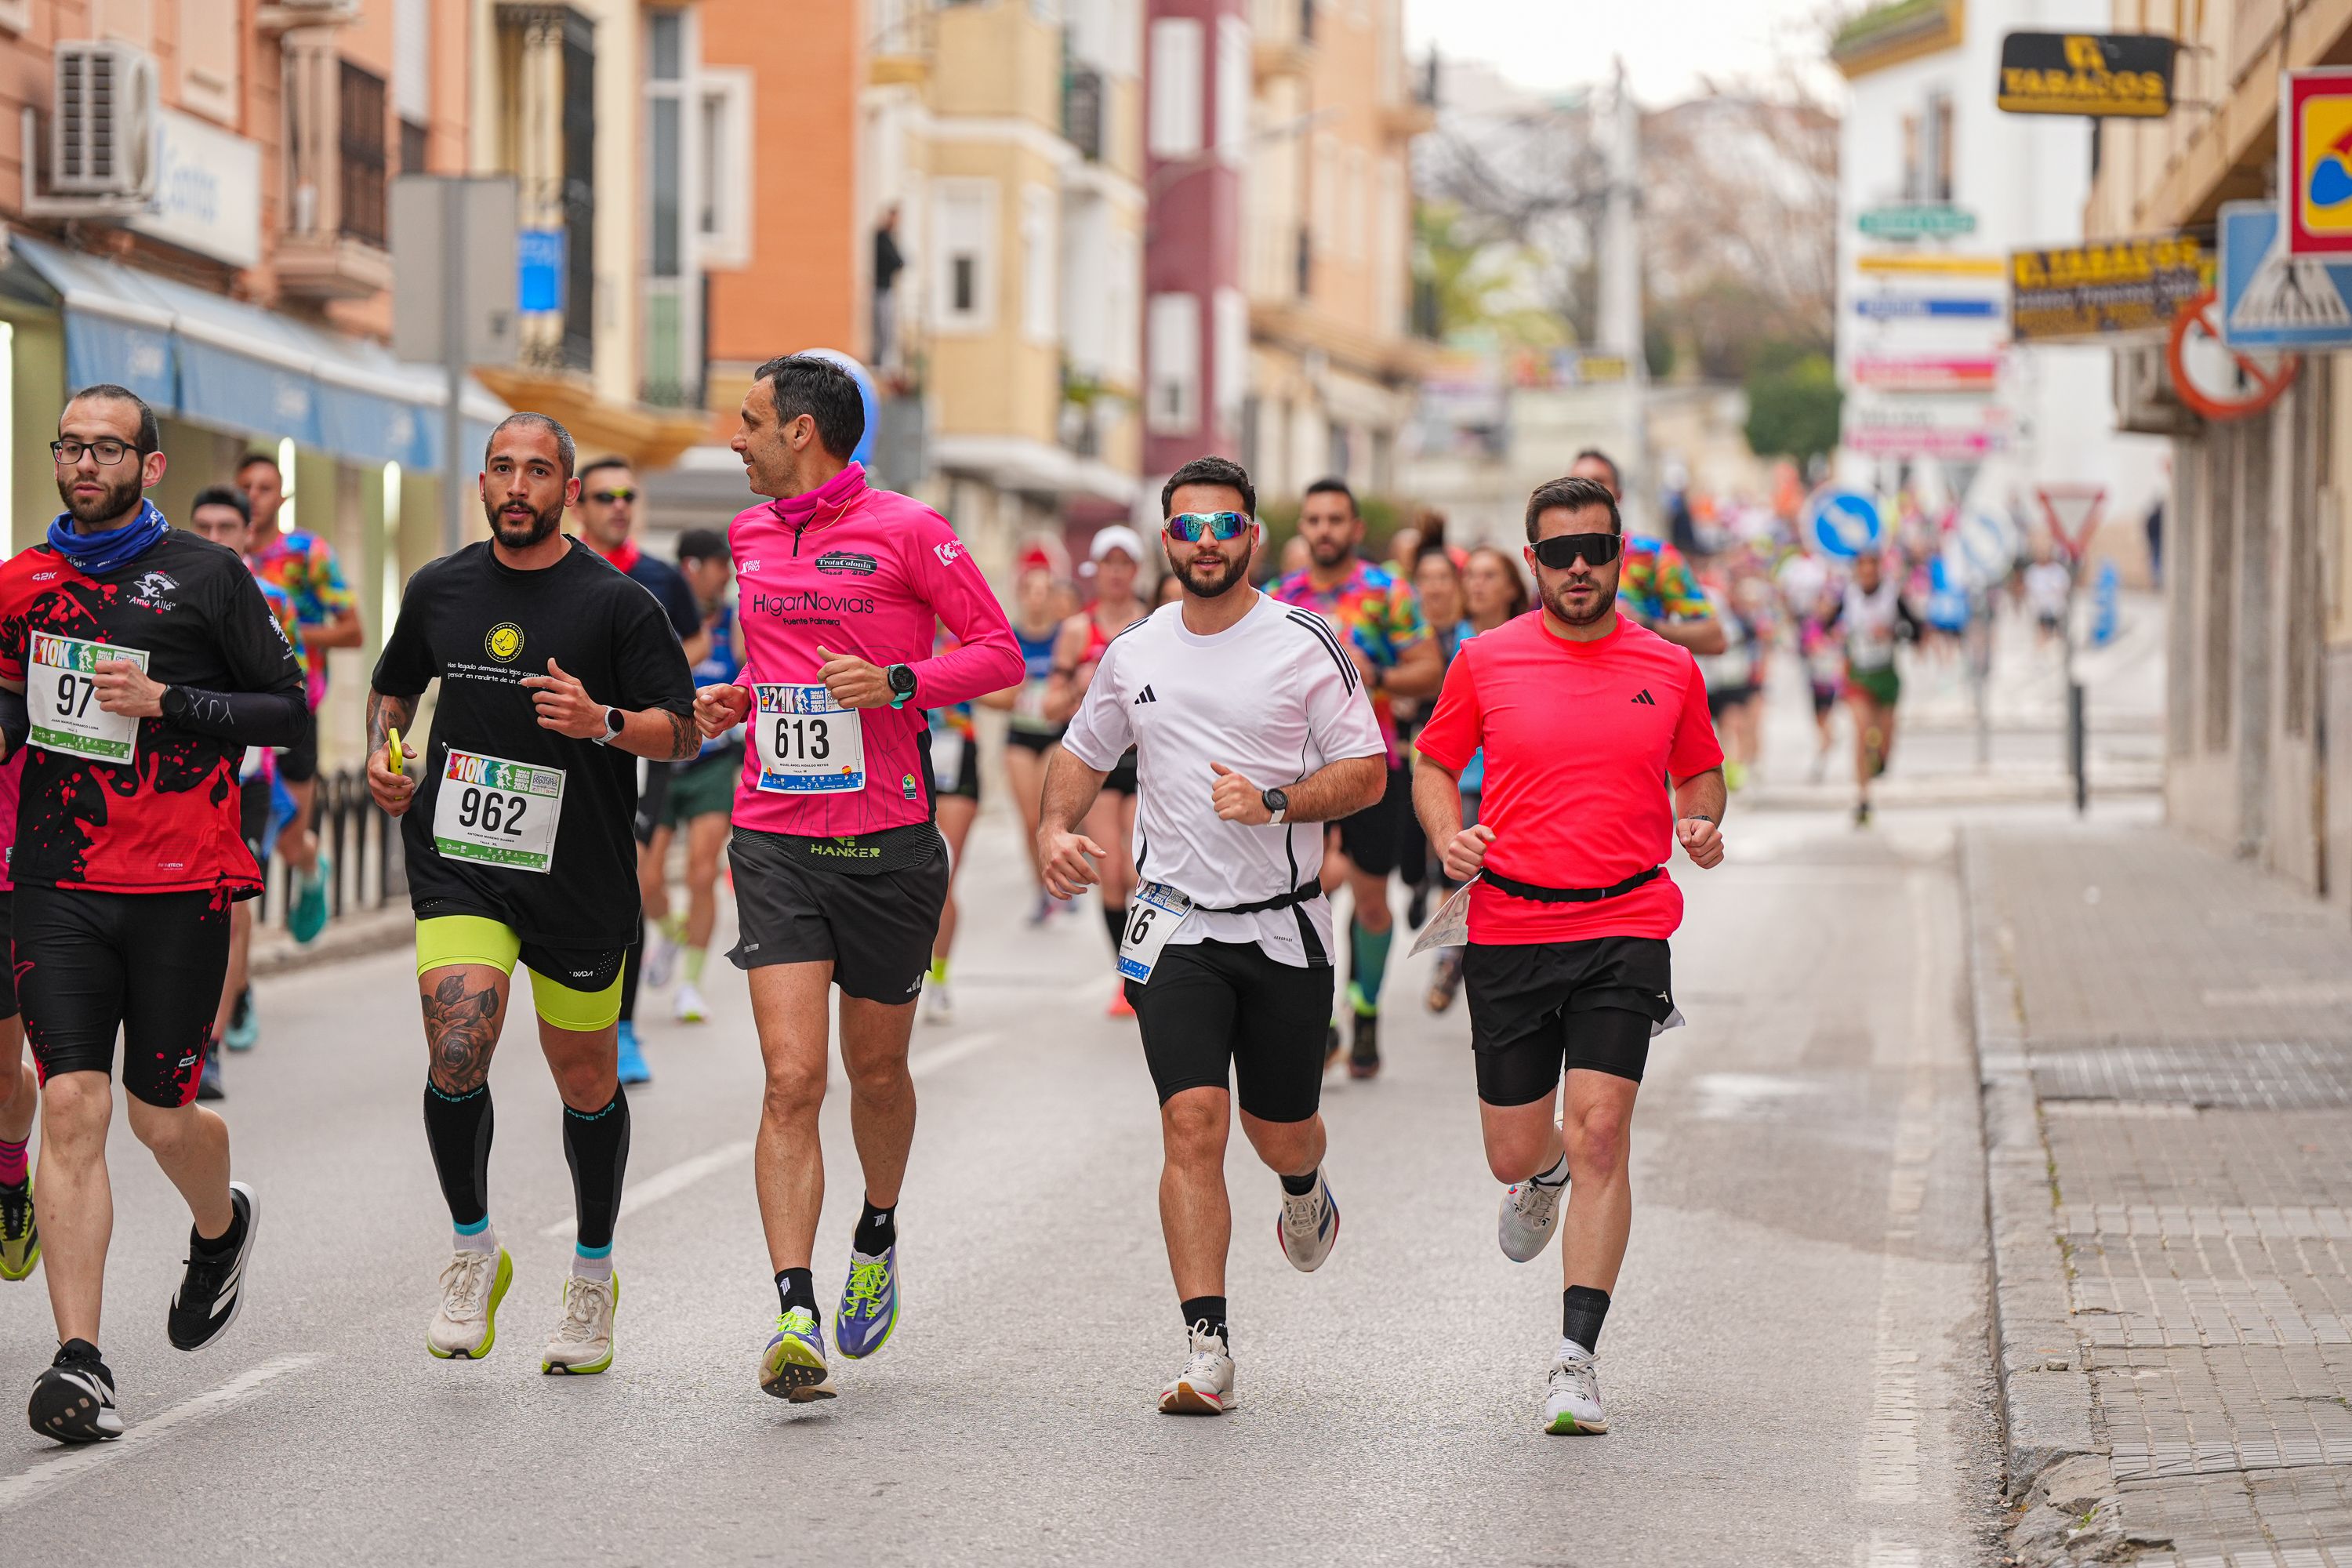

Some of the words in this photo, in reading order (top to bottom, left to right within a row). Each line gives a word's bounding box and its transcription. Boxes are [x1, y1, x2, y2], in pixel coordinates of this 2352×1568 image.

[32, 572, 57, 581] 42K
[818, 559, 871, 569] TrotaColonia
[753, 591, 874, 616] HigarNovias
[809, 618, 840, 626] Palmera
[40, 638, 72, 669] 10K
[457, 662, 477, 671] llegado
[477, 665, 508, 673] demasiado
[509, 668, 521, 677] lejos
[56, 673, 95, 718] 97
[769, 687, 795, 713] 21K
[811, 704, 826, 713] 2026
[775, 717, 829, 760] 613
[456, 756, 489, 785] 10K
[514, 782, 528, 791] 2026
[459, 787, 527, 836] 962
[810, 844, 880, 858] HANKER
[1124, 903, 1156, 945] 16
